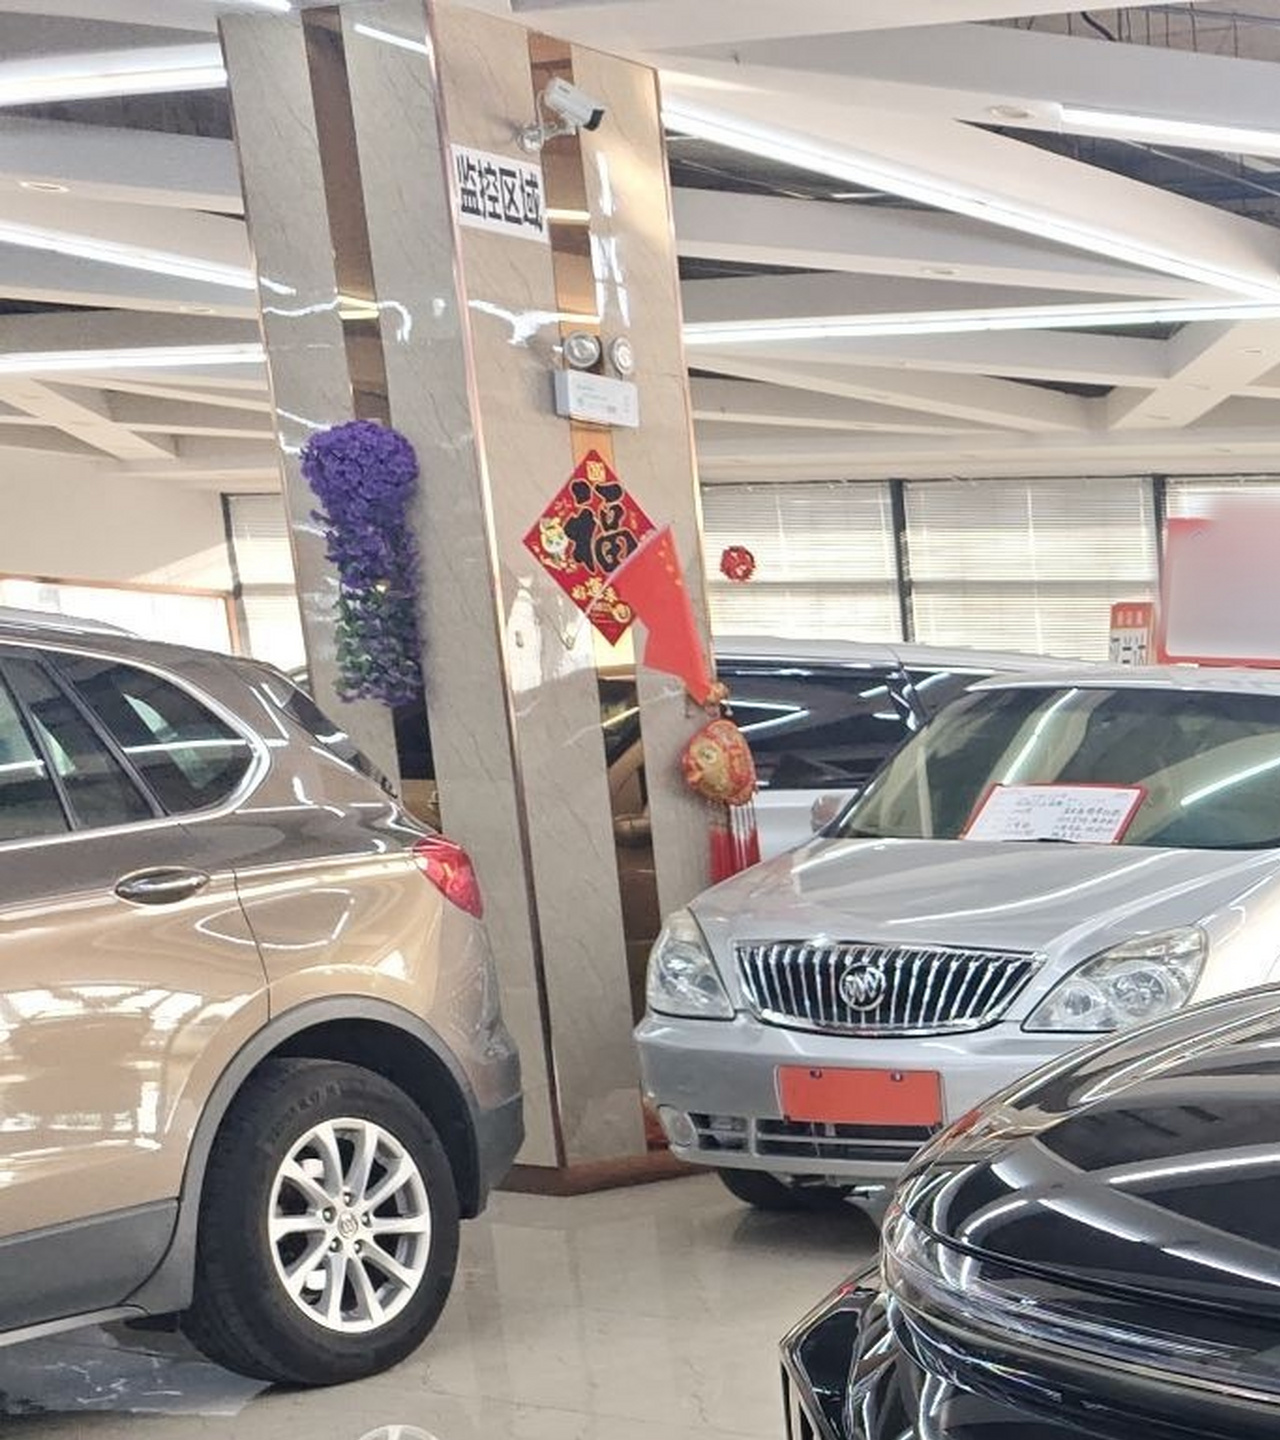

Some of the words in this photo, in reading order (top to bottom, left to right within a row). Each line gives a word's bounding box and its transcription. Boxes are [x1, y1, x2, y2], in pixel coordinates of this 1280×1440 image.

[456, 154, 542, 233] 监控区域
[563, 480, 639, 574] 福
